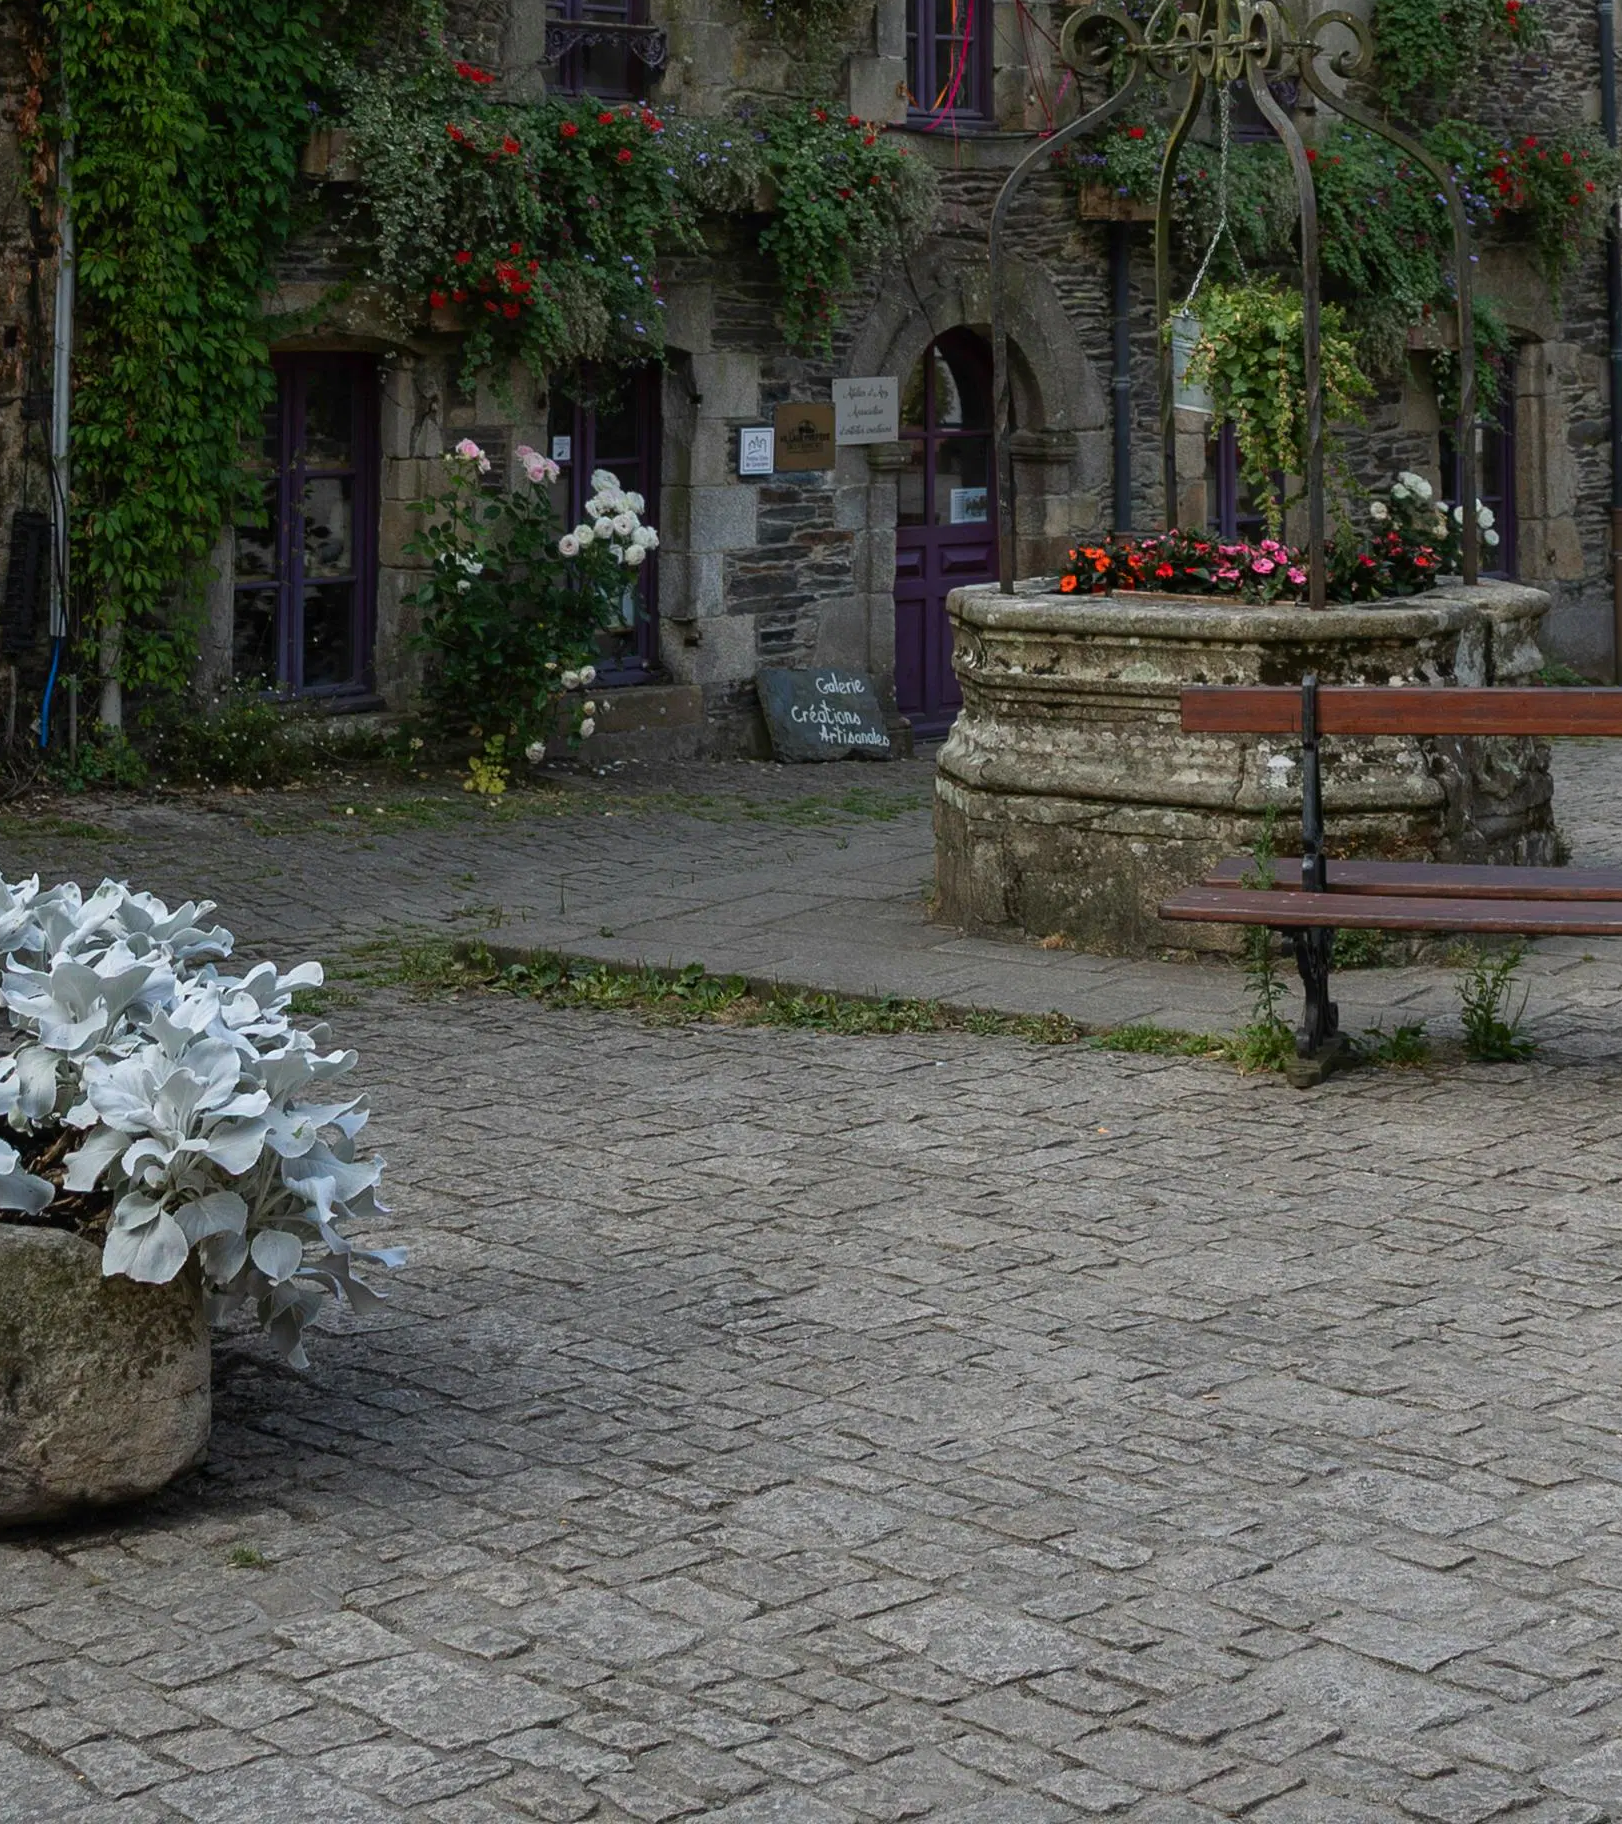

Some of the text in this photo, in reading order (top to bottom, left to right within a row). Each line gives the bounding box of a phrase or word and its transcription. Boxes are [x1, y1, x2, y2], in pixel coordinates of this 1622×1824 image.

[815, 671, 866, 695] Galerie
[790, 699, 862, 725] Créations
[819, 723, 891, 748] Artisanales
